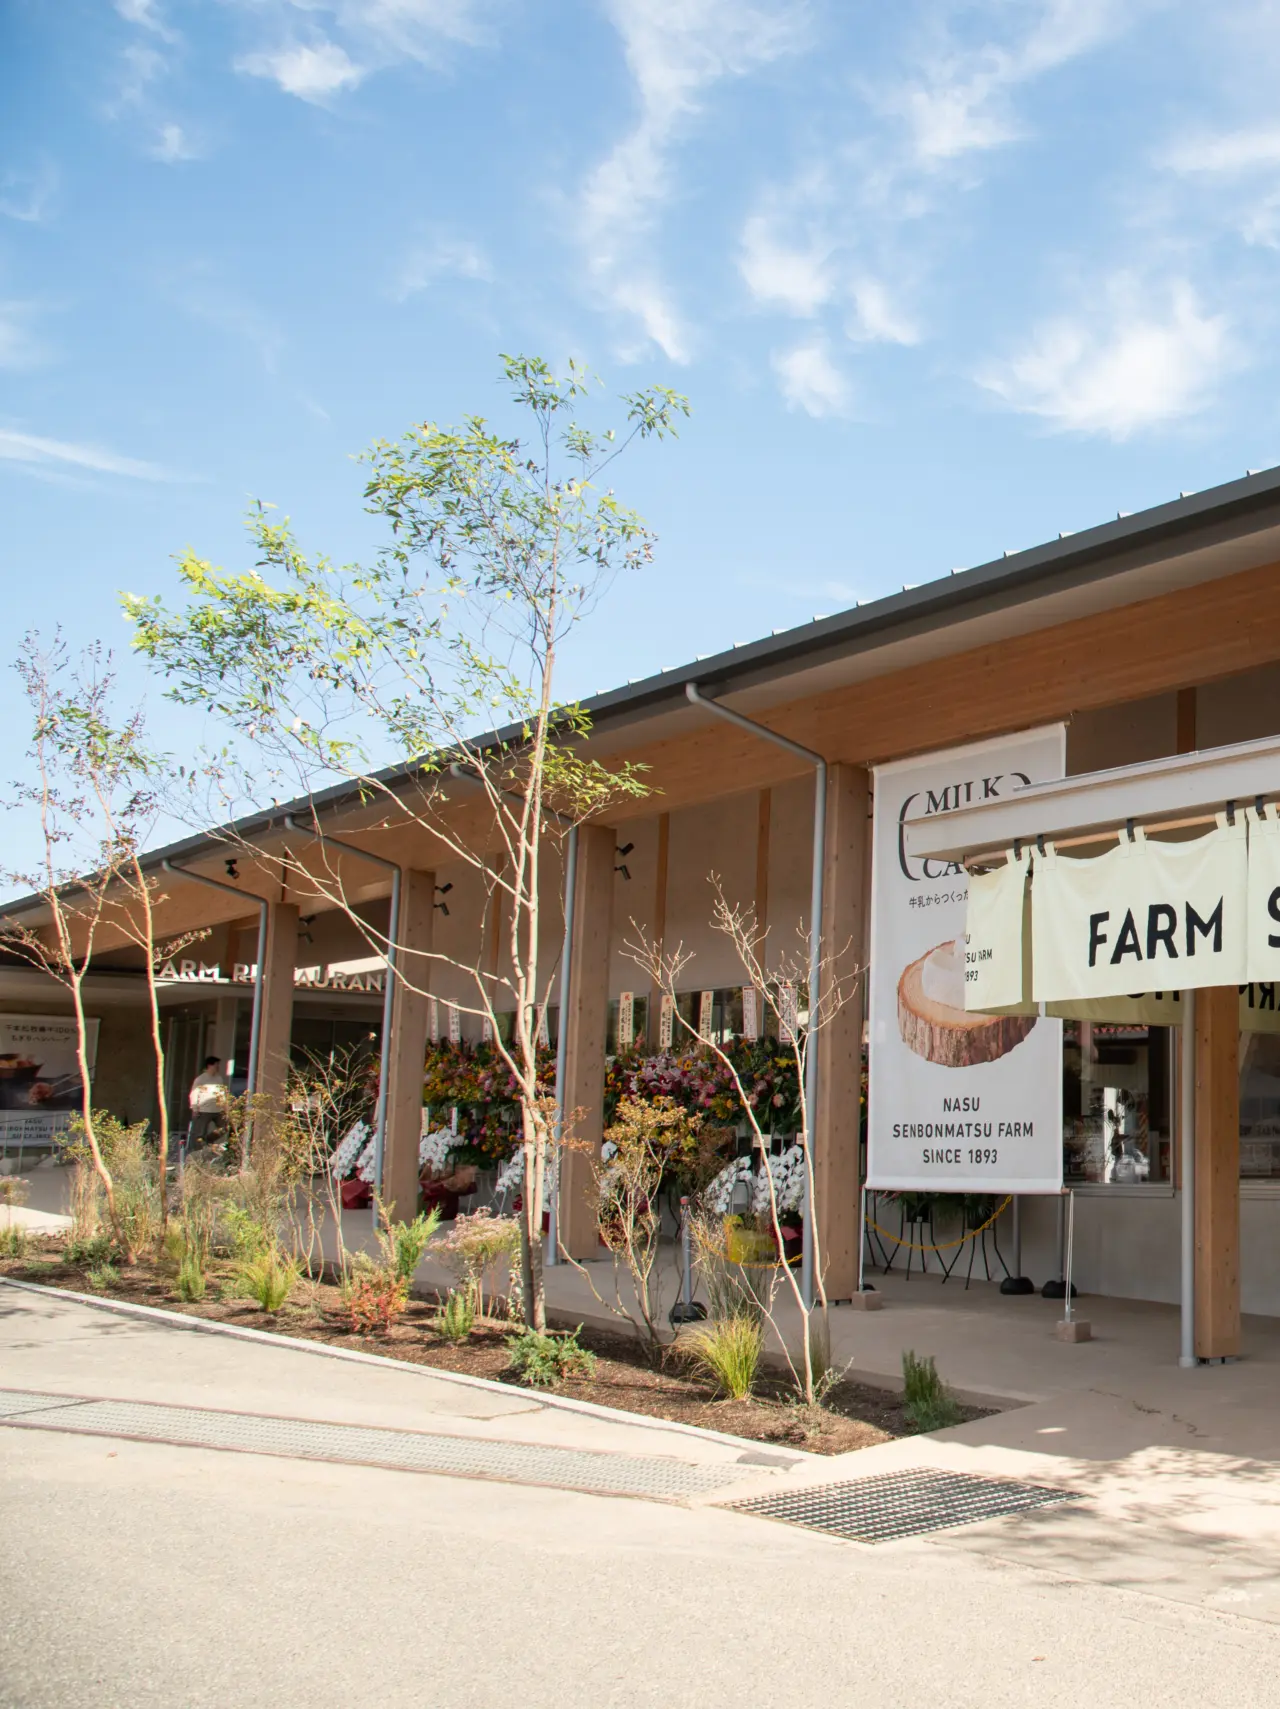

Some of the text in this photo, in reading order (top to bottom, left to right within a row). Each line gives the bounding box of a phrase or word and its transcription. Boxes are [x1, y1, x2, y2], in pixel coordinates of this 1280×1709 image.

[922, 859, 964, 879] CA
[1088, 895, 1224, 968] FARM
[153, 958, 221, 981] ARM
[943, 1097, 981, 1113] NASU
[892, 1122, 1034, 1139] SENBONMATSU FARM
[922, 1148, 998, 1164] SINCE 1893
